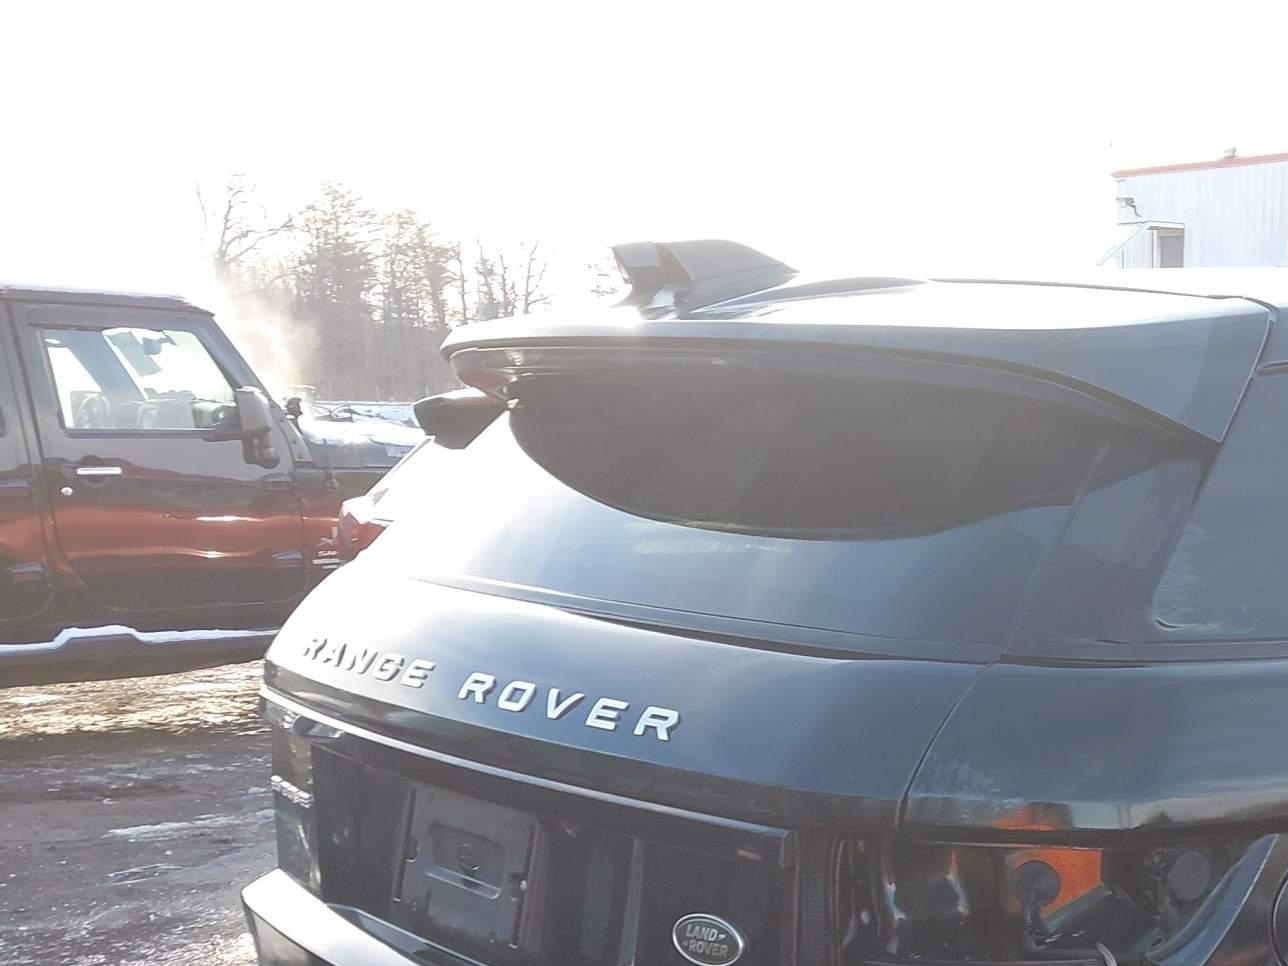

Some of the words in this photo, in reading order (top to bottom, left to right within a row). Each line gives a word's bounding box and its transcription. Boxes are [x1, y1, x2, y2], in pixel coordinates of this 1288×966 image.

[302, 638, 435, 688] RANGE
[458, 672, 680, 741] ROVER
[686, 924, 719, 941] LAND
[688, 939, 729, 958] ROVER
